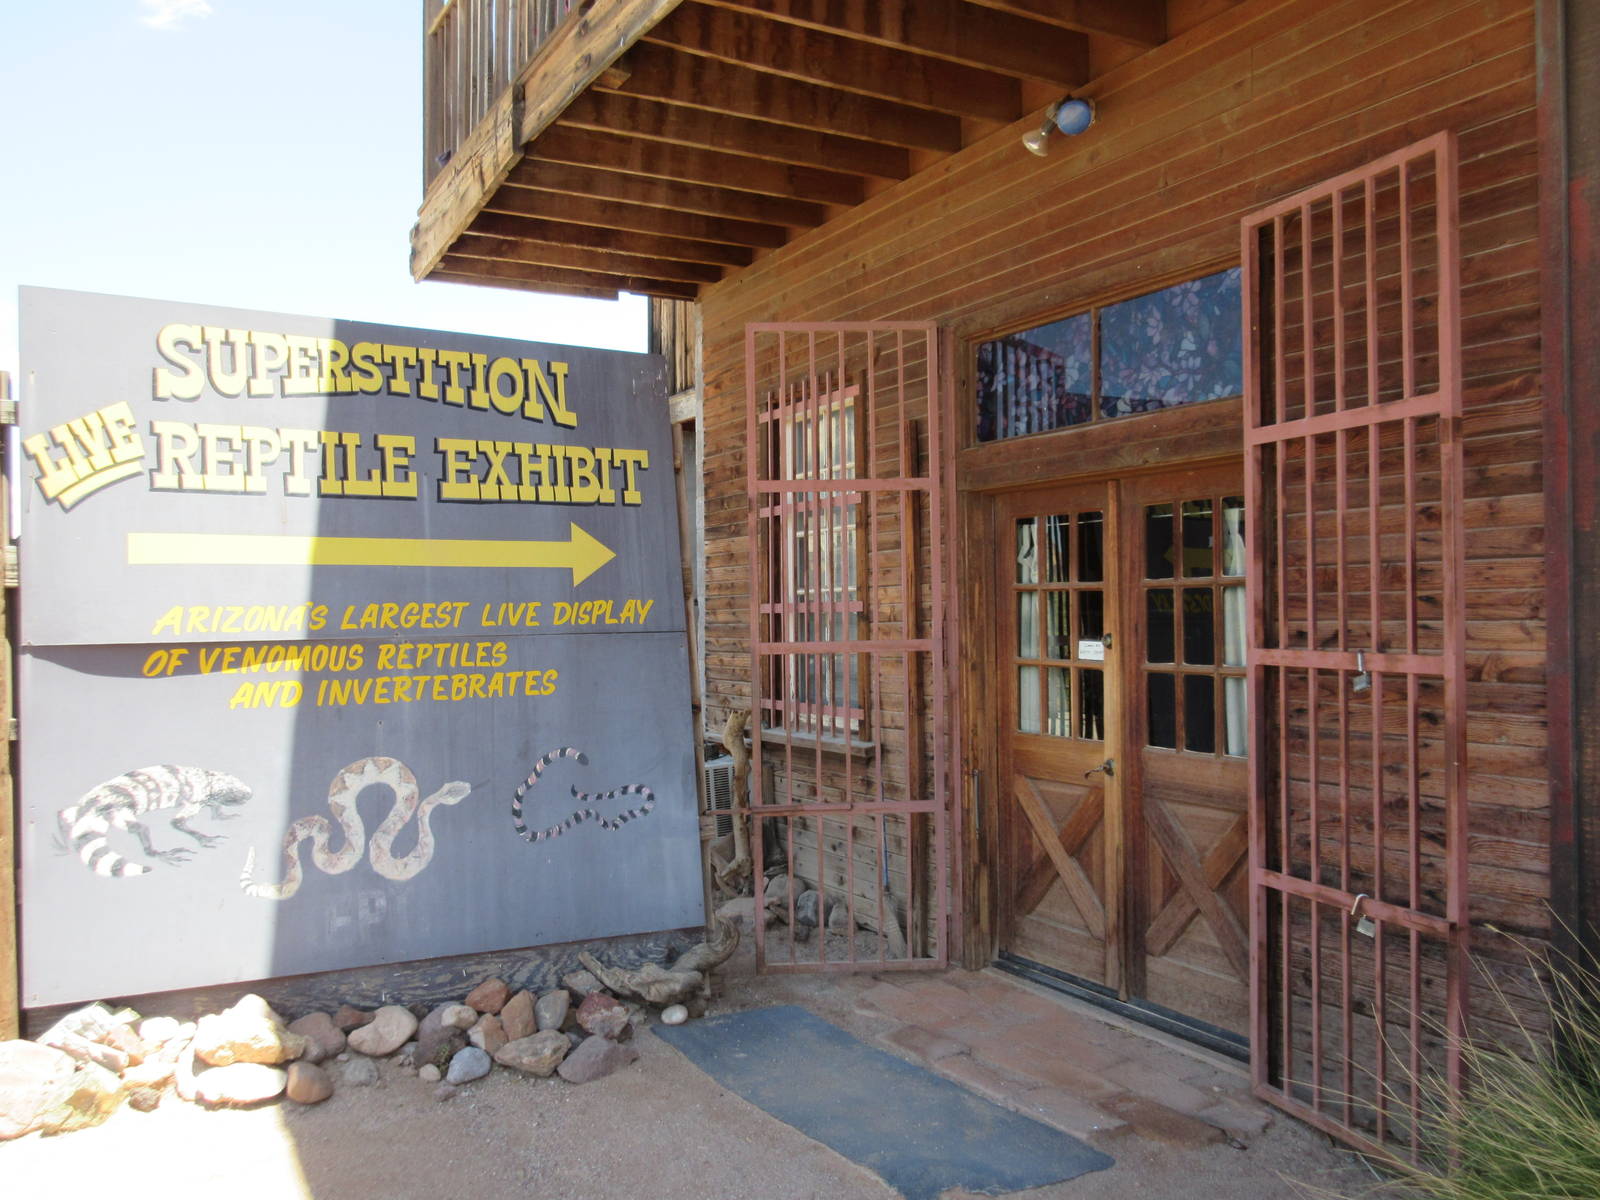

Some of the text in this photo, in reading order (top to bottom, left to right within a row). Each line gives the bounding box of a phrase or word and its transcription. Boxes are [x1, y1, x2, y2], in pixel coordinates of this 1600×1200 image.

[154, 325, 578, 428] SUPERSTITION
[23, 402, 145, 504] LIVE
[150, 422, 649, 504] REPTILE EXHIBIT
[152, 599, 655, 635] ARIZONA'S LARGEST LIVE DISPLAY
[142, 641, 508, 677] OF VENOMOUS REPTILES
[229, 670, 559, 710] AND INVERTEBRATES
